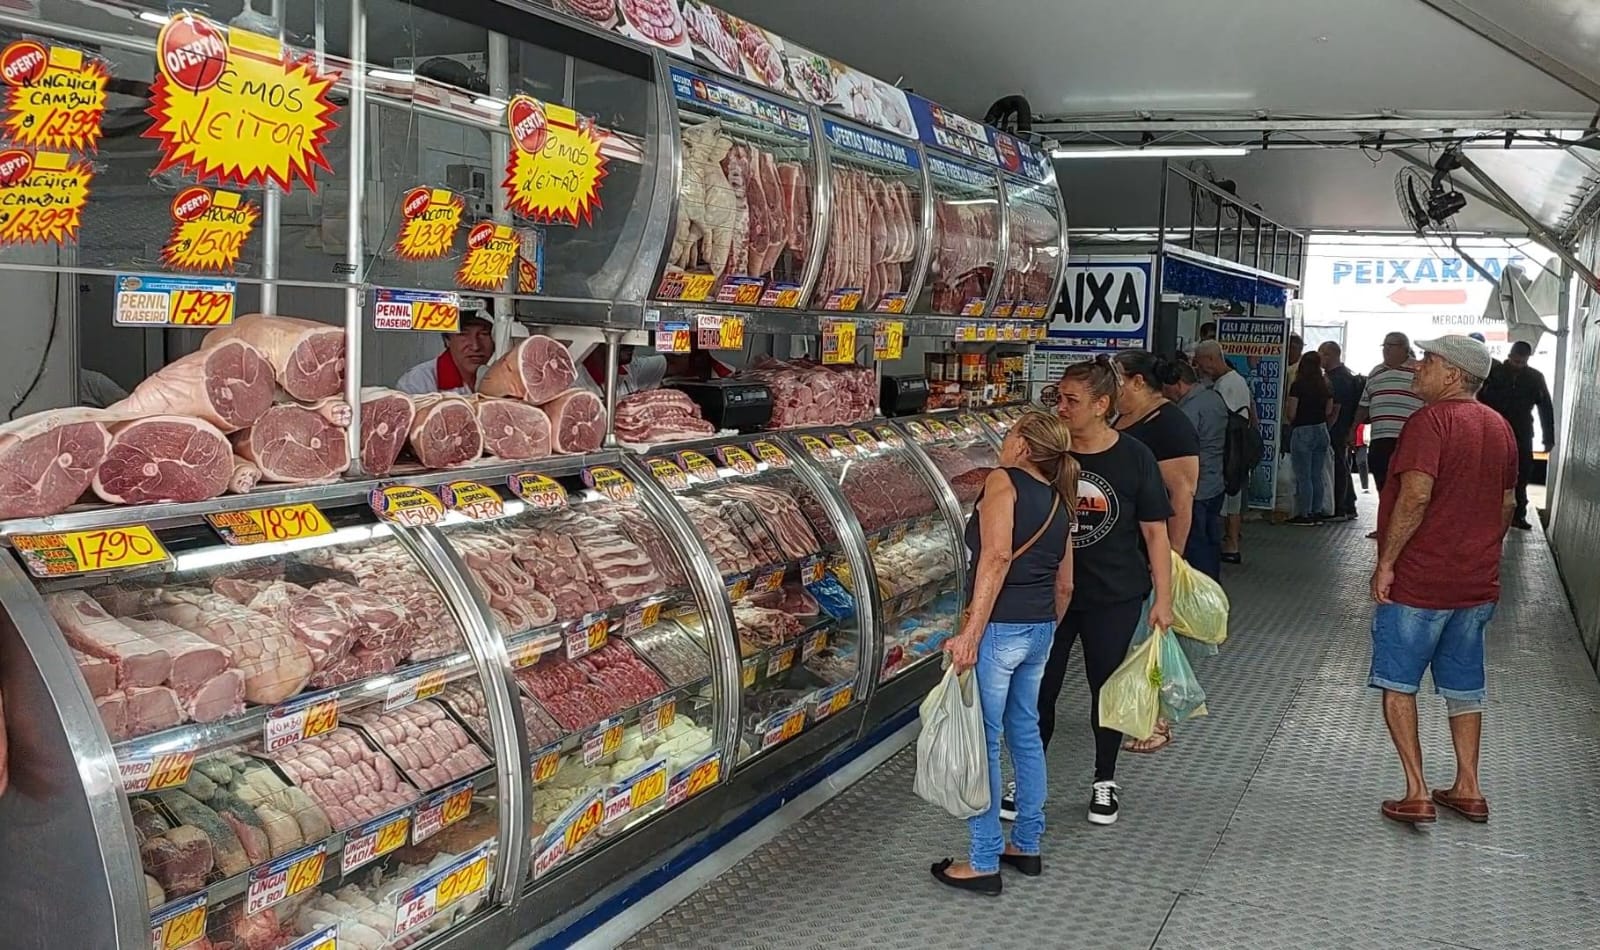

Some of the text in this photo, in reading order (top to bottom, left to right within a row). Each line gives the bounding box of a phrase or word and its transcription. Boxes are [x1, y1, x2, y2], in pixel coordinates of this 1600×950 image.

[166, 35, 223, 73] OFERTA
[4, 50, 43, 78] OFERTA
[184, 48, 303, 113] TEMOS
[514, 113, 545, 140] OFERTA
[0, 156, 29, 177] ERTA
[176, 194, 209, 216] OFERTA
[406, 194, 429, 213] OFERTA
[470, 229, 492, 244] OFERTA
[120, 293, 167, 310] PERNIL
[120, 310, 167, 322] TRASEIRO
[377, 304, 411, 317] PERNIL
[376, 318, 412, 328] TRASEIRO
[1222, 322, 1239, 332] CASA
[1240, 323, 1250, 332] DE
[1432, 315, 1475, 325] MERCADO
[208, 511, 253, 527] LOMBO
[271, 732, 299, 749] COPA
[118, 762, 151, 777] OMBO
[123, 778, 149, 791] ORCO
[606, 797, 631, 818] TRIPA
[345, 846, 375, 869] SADIA
[251, 872, 288, 896] LINGUA
[250, 890, 284, 912] DE BOI
[396, 921, 407, 934] DE
